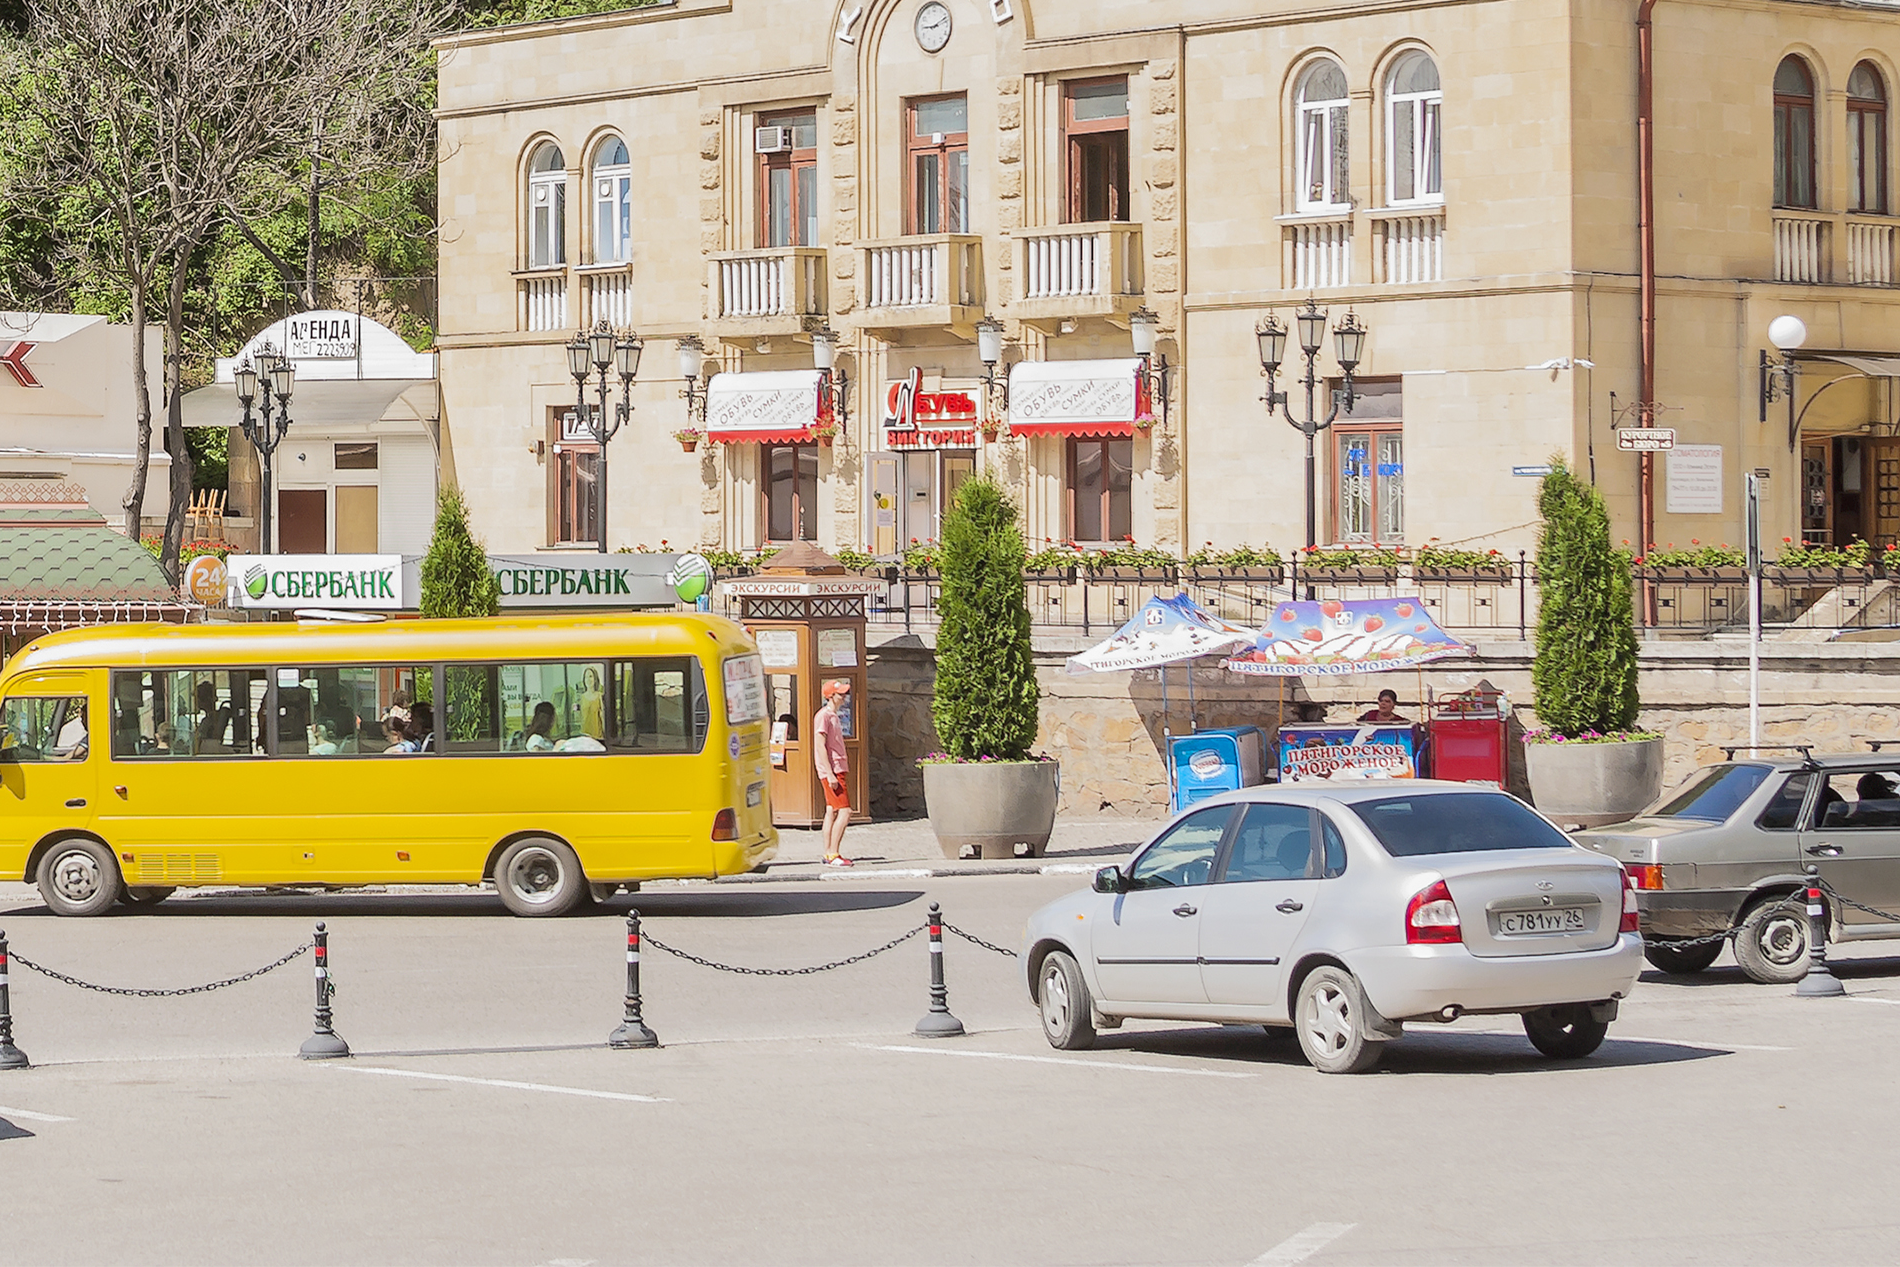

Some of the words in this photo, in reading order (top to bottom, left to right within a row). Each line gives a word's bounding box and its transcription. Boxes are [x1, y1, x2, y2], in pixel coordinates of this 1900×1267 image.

[290, 319, 351, 342] АРЕНДА
[752, 390, 782, 419] СУМКИ
[1023, 383, 1062, 418] ОБУВЬ
[1061, 379, 1095, 411] СУМКИ
[719, 393, 754, 425] ОБУВЬ
[887, 429, 975, 446] ВИКТОРИЯ
[195, 567, 221, 588] 24
[271, 568, 396, 601] СБЕРБАНК
[499, 568, 631, 596] СБЕРБАНК
[730, 583, 801, 594] ЭКСКУРСИИ
[816, 583, 881, 594] ЭКСКУРСИИ
[1288, 744, 1405, 763] ПЯТИГОРСКОЕ
[1297, 757, 1398, 776] МОРОЖЕНОЕ
[1506, 913, 1562, 932] С781УУ
[1565, 910, 1582, 924] 26
